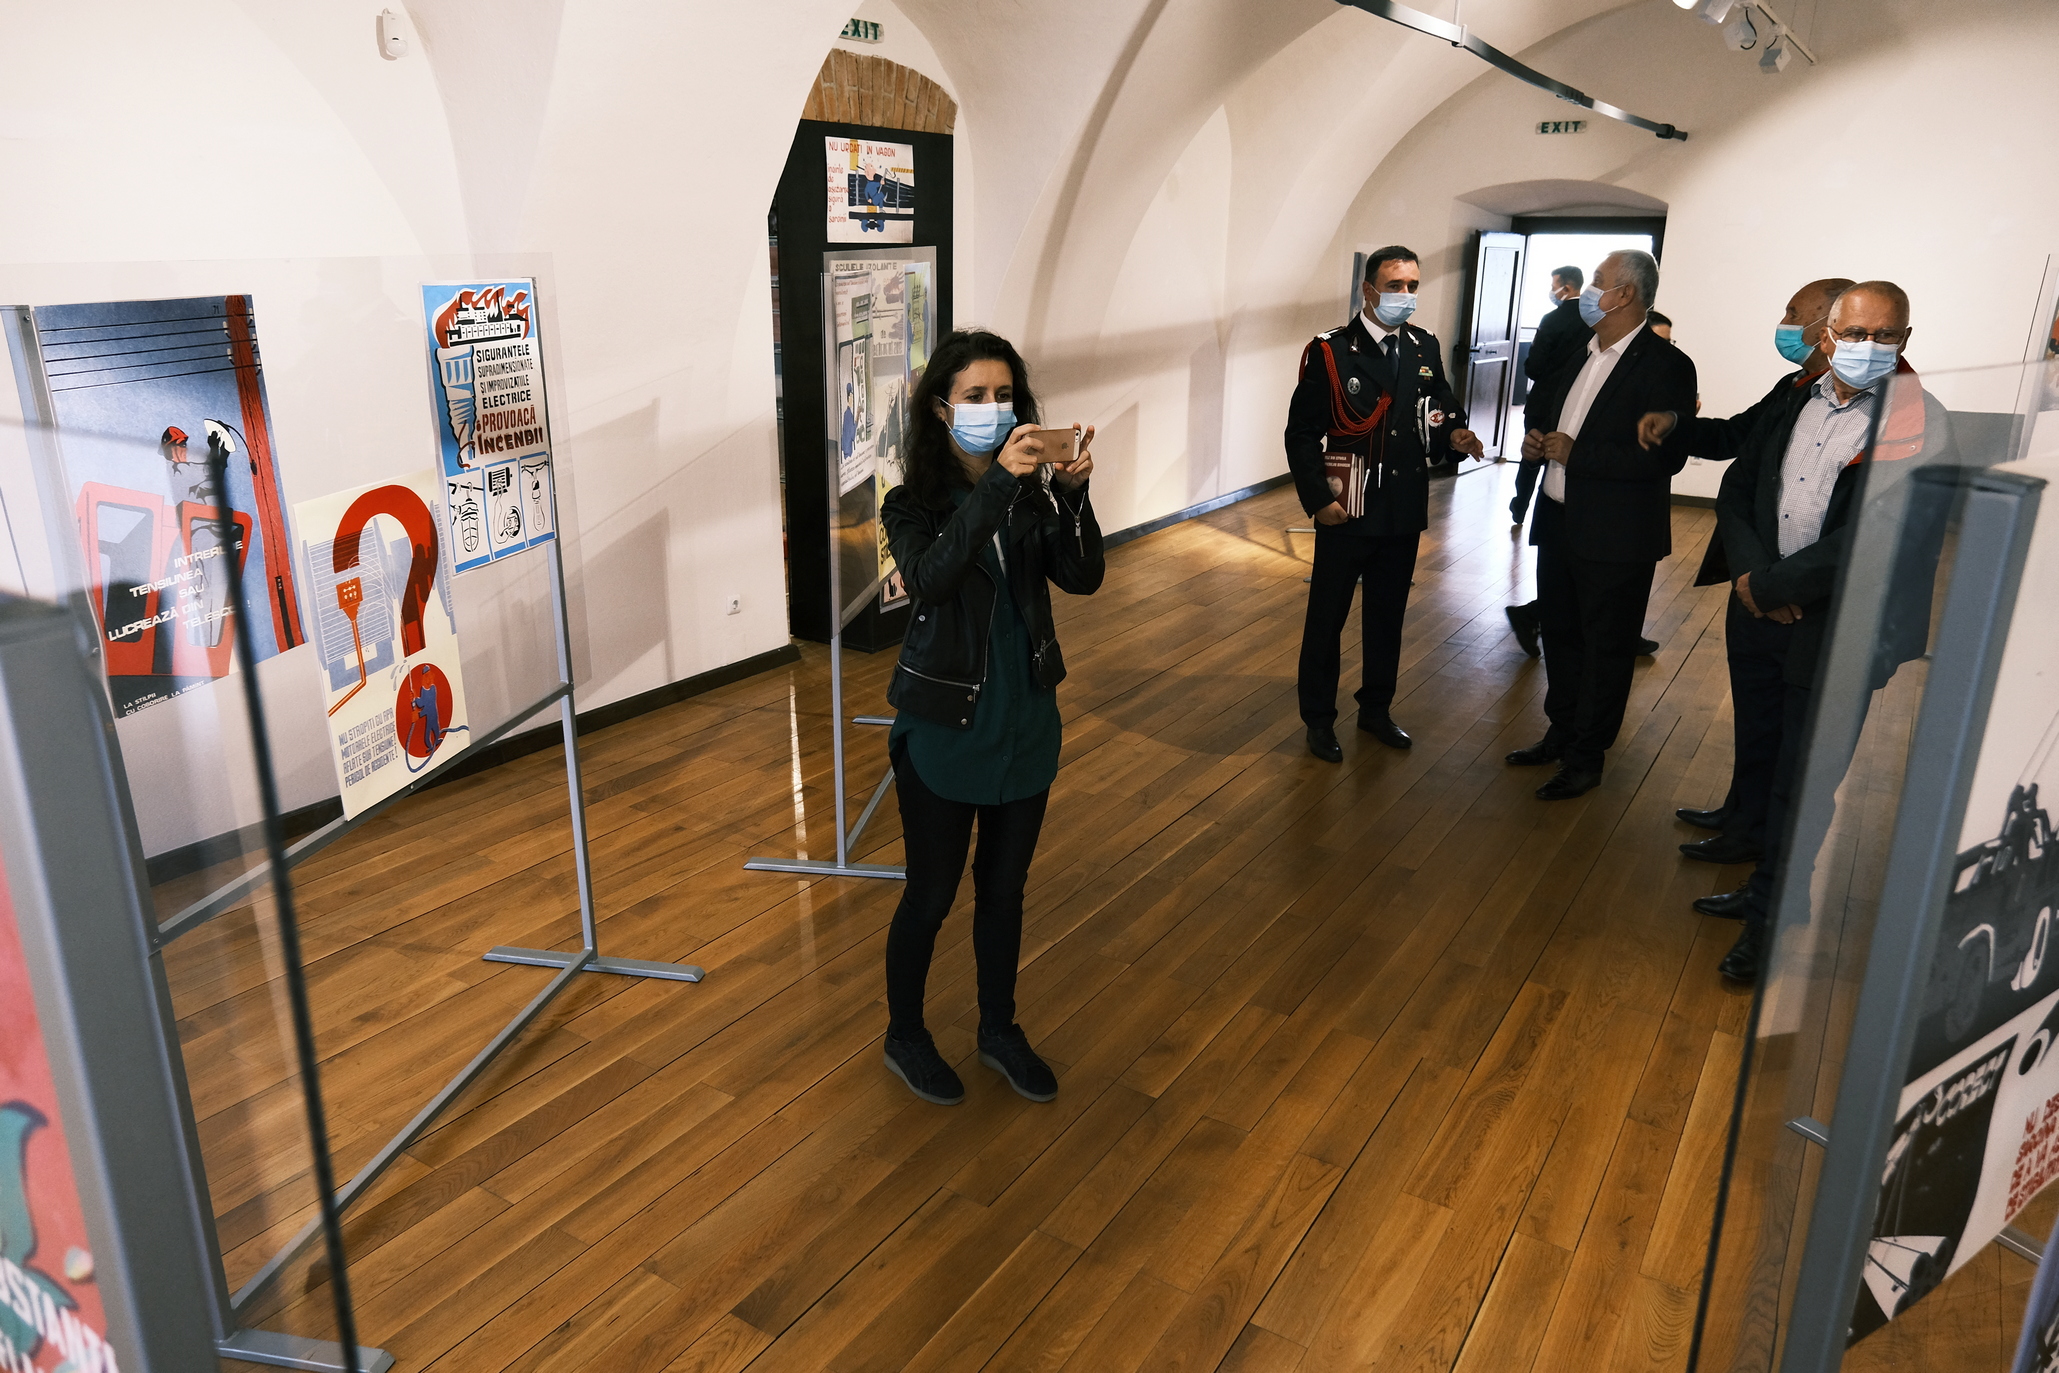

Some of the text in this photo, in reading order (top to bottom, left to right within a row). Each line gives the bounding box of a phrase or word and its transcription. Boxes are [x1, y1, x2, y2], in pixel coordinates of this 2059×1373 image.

[1541, 121, 1581, 133] EXIT
[829, 142, 838, 151] NU
[876, 146, 896, 157] VAGON
[477, 358, 533, 378] SUPRADIMENSIONATE
[482, 389, 531, 409] ELECTRICE
[482, 404, 537, 433] PROVOACĂ
[129, 567, 203, 597] TENSIUNEA
[179, 583, 205, 599] SAU
[108, 599, 204, 642] LUCREAZĂ DIN
[125, 708, 136, 716] CU
[171, 690, 181, 698] LA
[338, 731, 348, 746] NU
